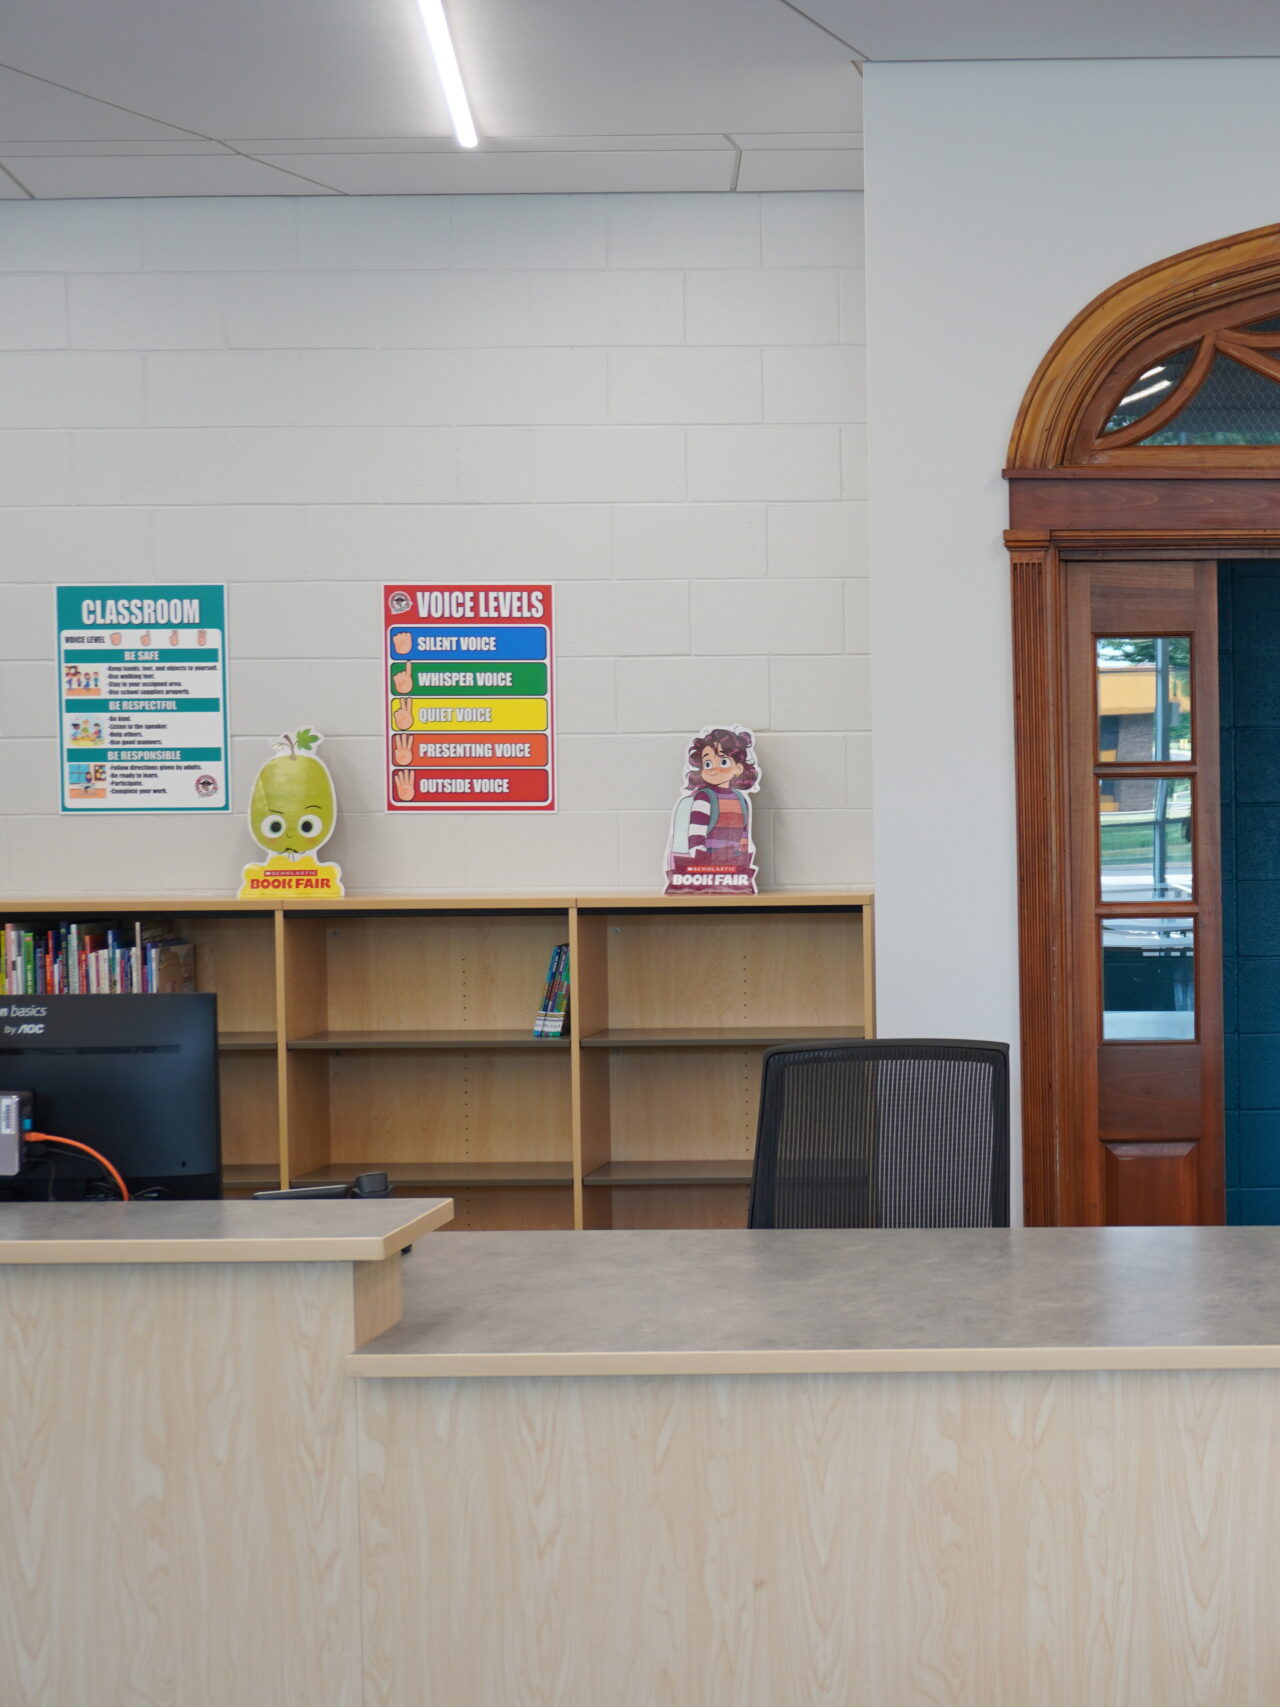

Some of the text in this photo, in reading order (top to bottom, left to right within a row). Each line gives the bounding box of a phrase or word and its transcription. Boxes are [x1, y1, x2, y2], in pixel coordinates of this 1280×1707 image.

[416, 591, 475, 618] VOICE
[478, 591, 544, 618] LEVELS
[81, 598, 200, 625] CLASSROOM
[64, 636, 105, 644] VOICE LEVEL
[417, 636, 497, 651] SILENT VOICE
[124, 651, 160, 661] BE SAFE
[418, 672, 513, 687] WHISPER VOICE
[108, 701, 177, 711] BE RESPECTFUL
[419, 707, 493, 724] QUIET VOICE
[107, 751, 181, 761] BE RESPONSIBLE
[419, 743, 531, 758] PRESENTING VOICE
[419, 778, 509, 793] OUTSIDE VOICE
[250, 878, 331, 889] BOOK FAIR
[672, 874, 749, 886] BOOK FAIR
[10, 1004, 48, 1017] basics
[4, 1023, 46, 1035] by AOC
